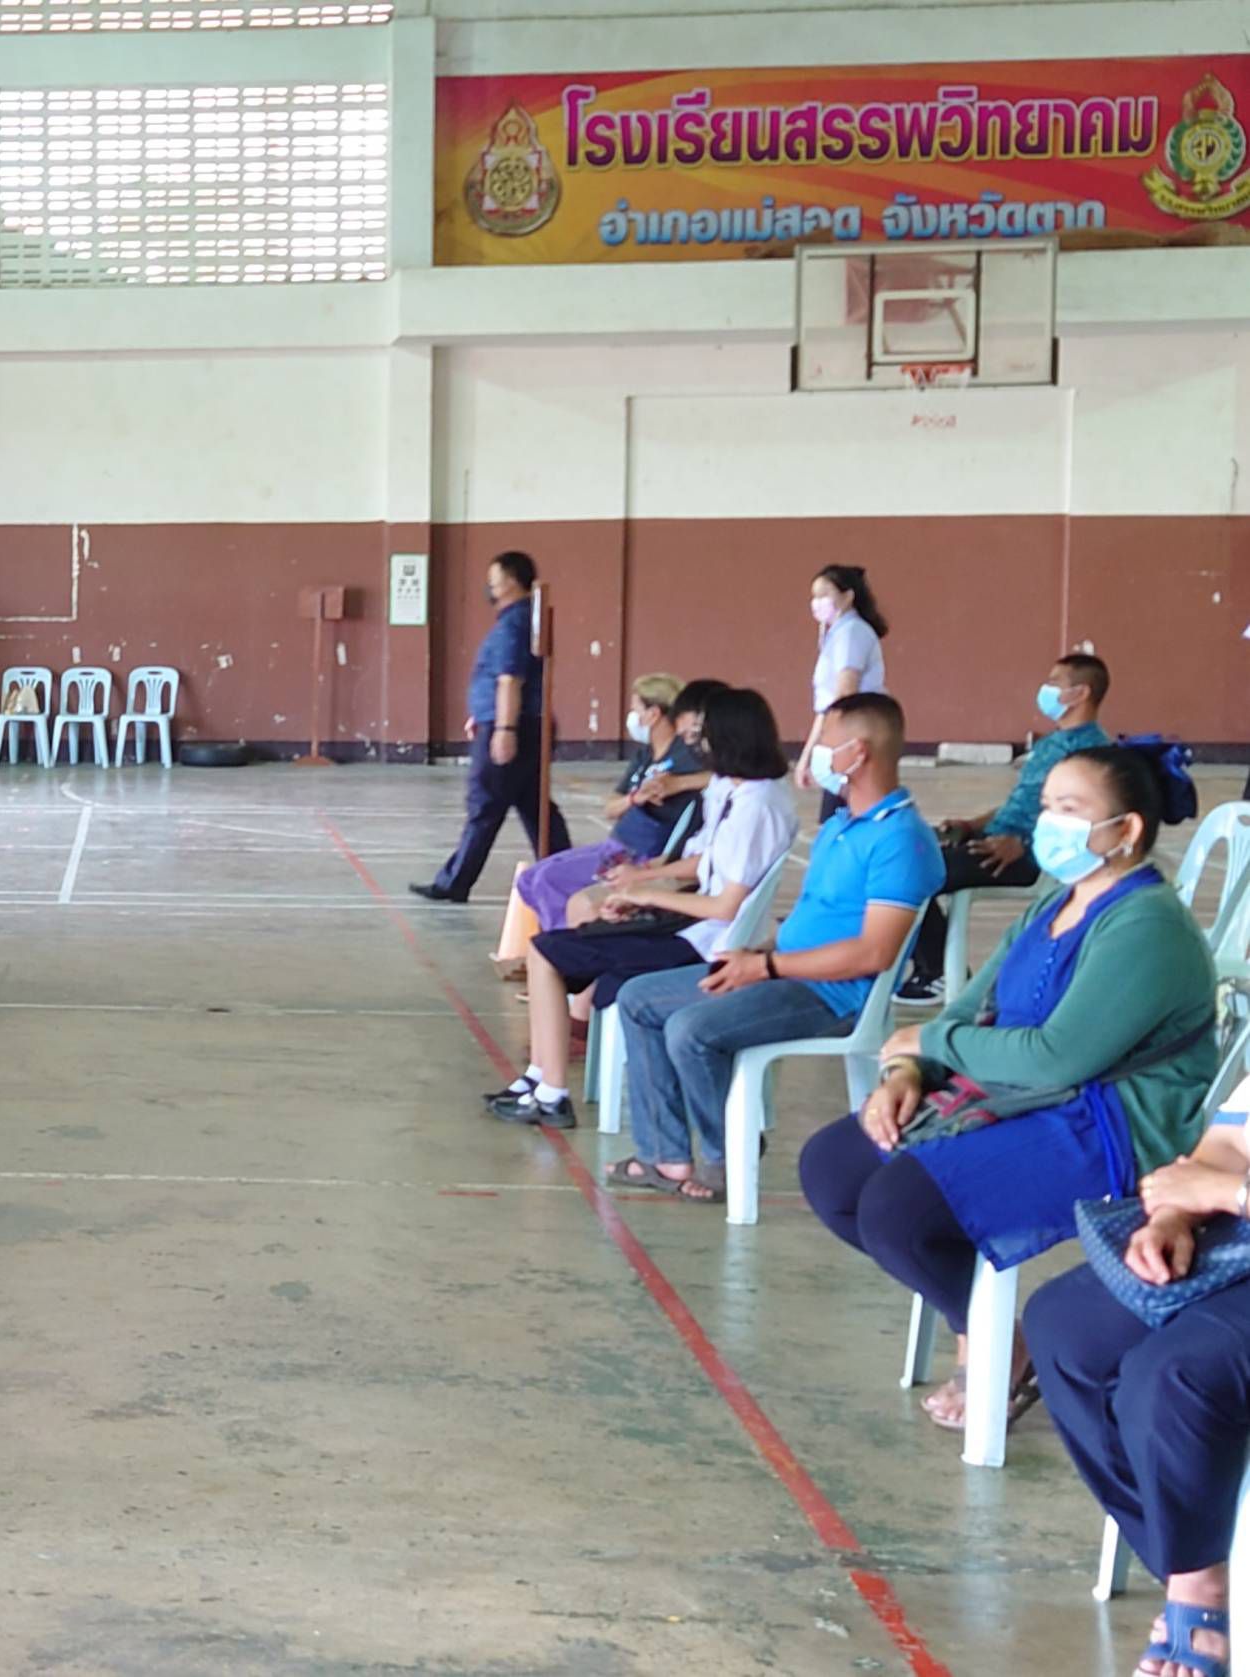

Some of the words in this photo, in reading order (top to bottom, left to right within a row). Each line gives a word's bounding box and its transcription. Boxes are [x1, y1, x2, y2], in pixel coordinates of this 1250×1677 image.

[564, 86, 1158, 168] โรงเรียนสรรพวิทยาคม
[882, 191, 1106, 239] จังหวัดตาก
